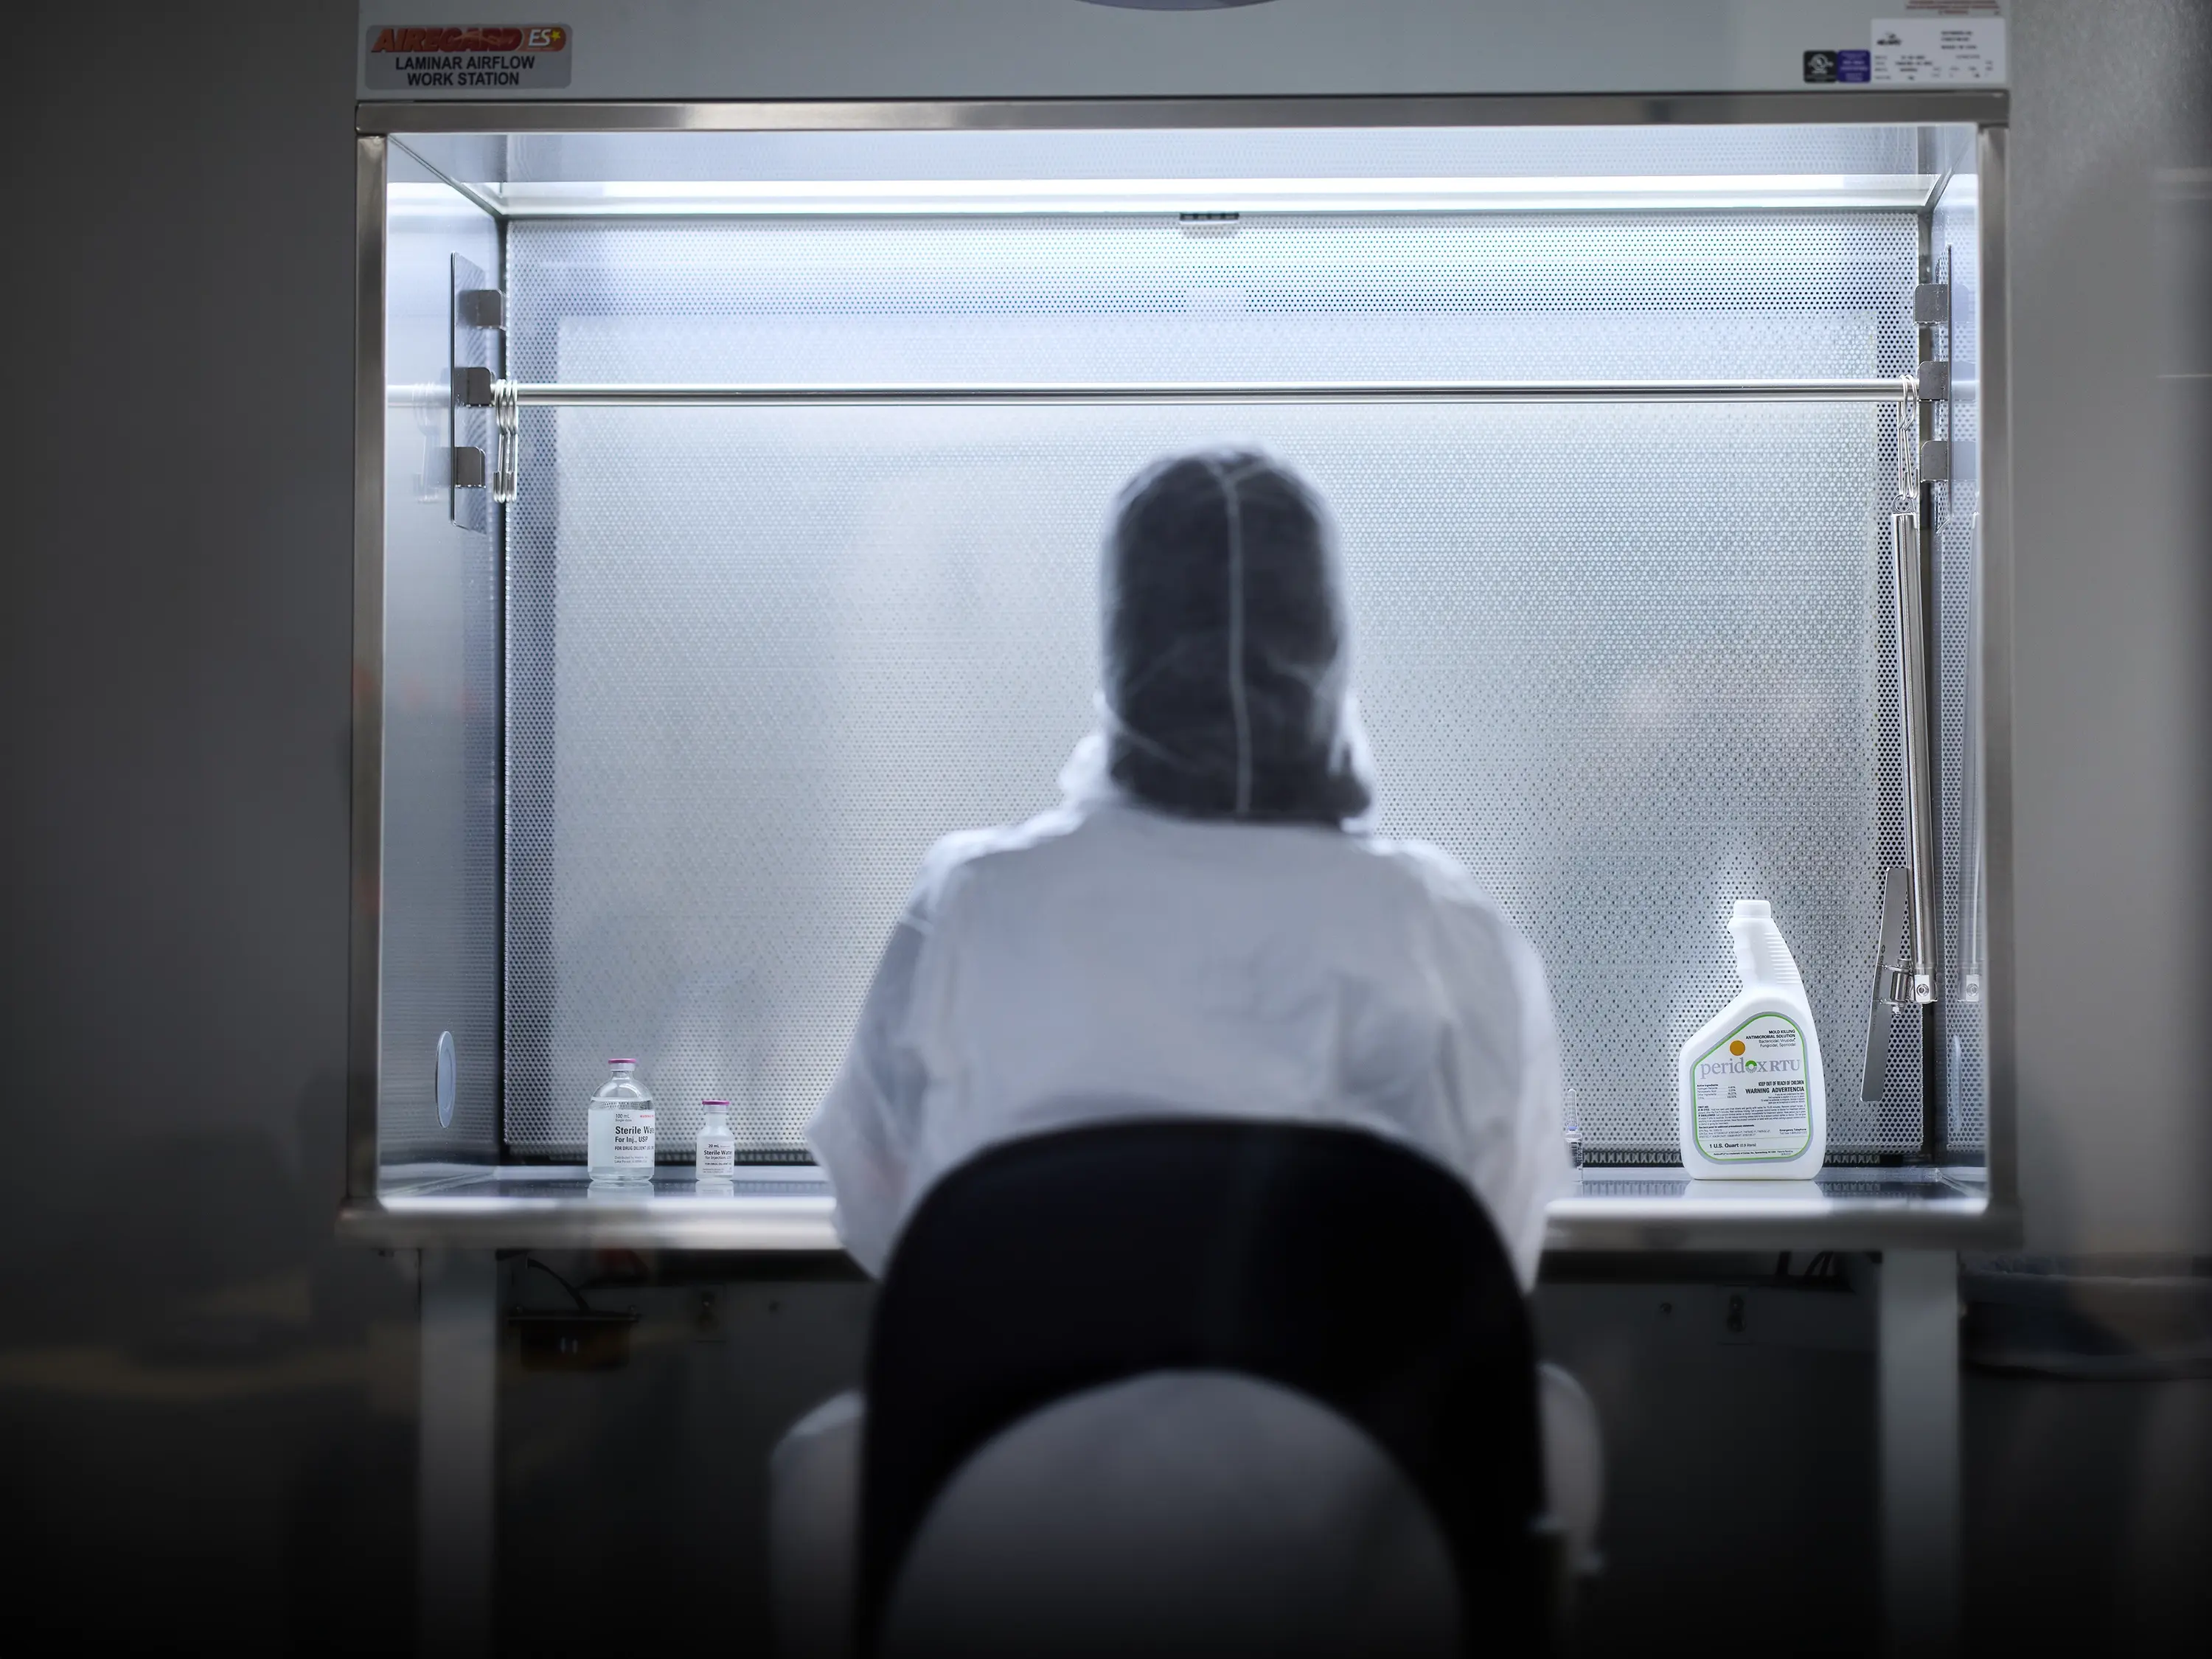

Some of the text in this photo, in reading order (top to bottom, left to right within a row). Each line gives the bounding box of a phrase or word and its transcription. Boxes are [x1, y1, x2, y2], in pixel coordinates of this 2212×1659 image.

[371, 27, 552, 52] AIREGARD ES
[395, 55, 535, 71] LAMINAR AIRFLOW
[407, 72, 520, 87] WORK STATION
[615, 1126, 641, 1134] Sterile
